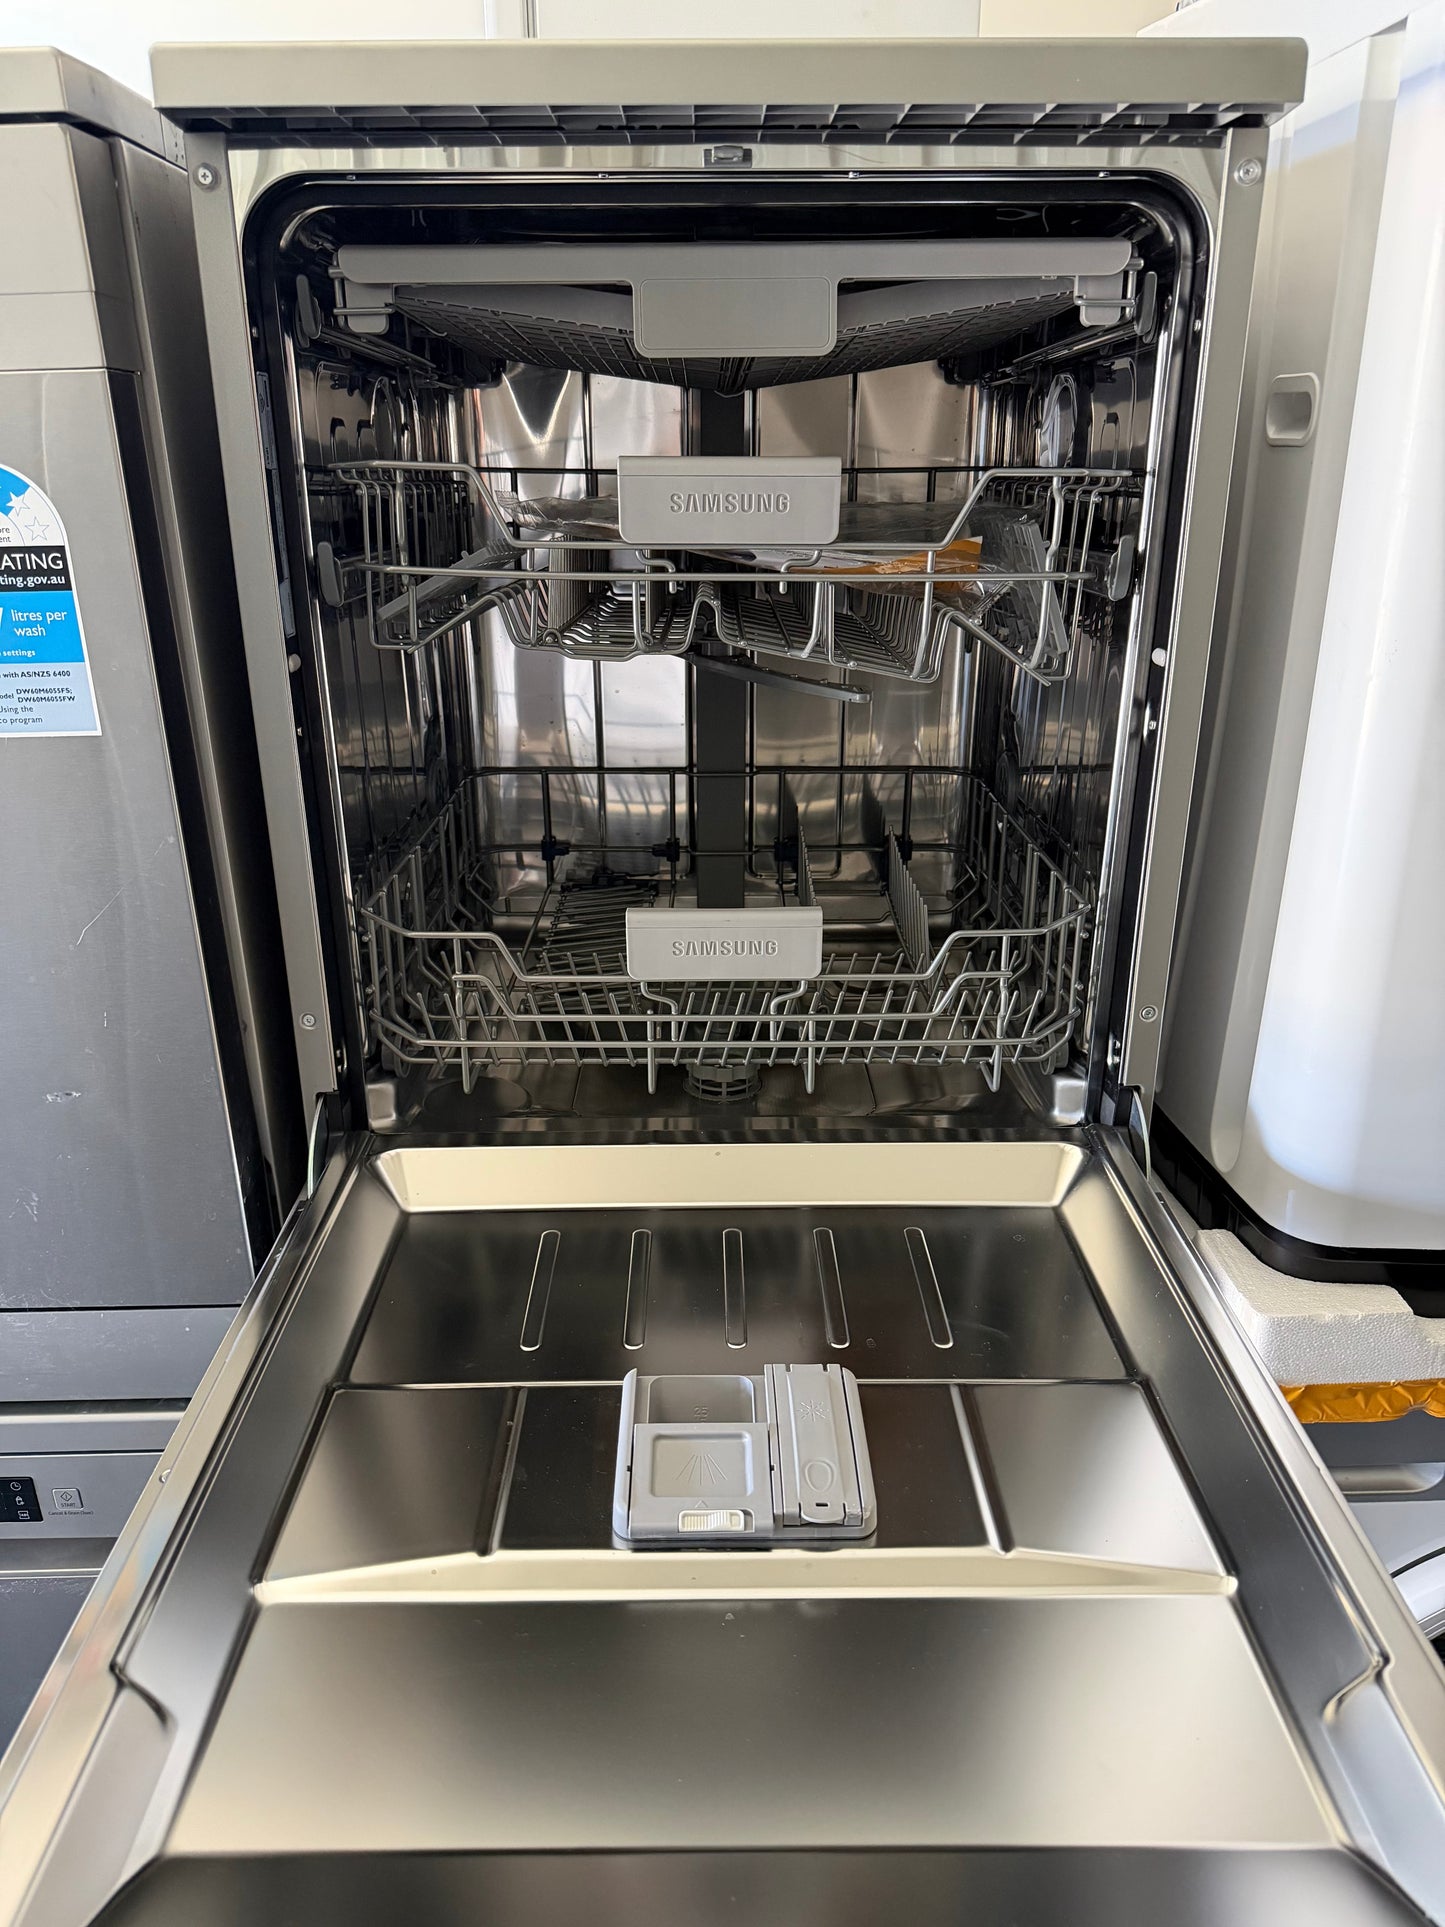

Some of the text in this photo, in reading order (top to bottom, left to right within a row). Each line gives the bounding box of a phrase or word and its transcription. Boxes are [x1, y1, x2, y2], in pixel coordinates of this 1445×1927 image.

[670, 493, 790, 514] SAMSUNG
[0, 552, 63, 571] ATING
[11, 609, 42, 622] litres
[46, 611, 67, 624] per
[14, 624, 46, 636] wash
[3, 649, 36, 657] settings
[21, 705, 34, 713] the
[10, 717, 43, 725] program
[671, 940, 778, 957] SAMSUNG
